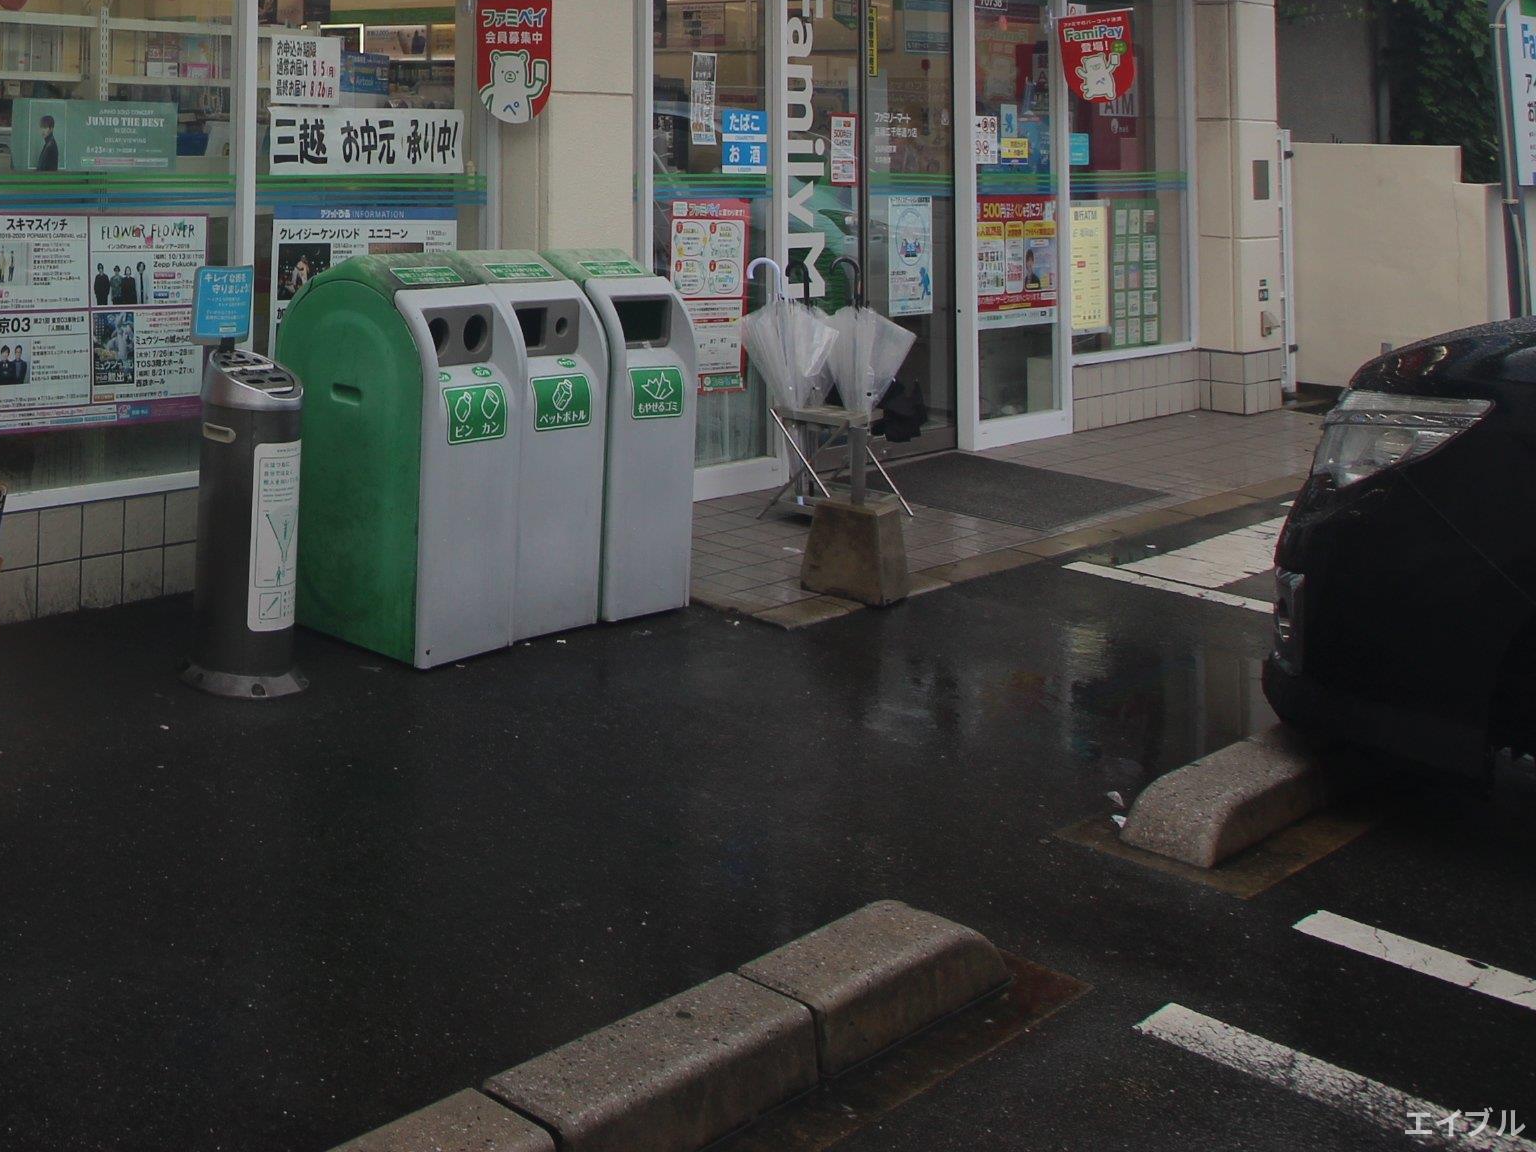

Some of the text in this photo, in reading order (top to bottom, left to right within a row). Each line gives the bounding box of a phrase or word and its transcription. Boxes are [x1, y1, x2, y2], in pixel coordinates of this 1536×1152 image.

[482, 8, 547, 27] ファミペイ
[486, 32, 542, 44] 会員募集中
[1063, 25, 1124, 42] FamiPay
[276, 59, 308, 76] 通常お届け
[503, 102, 520, 115] ペ
[86, 116, 165, 128] JUNHO THE BEST
[729, 113, 760, 132] たばこ
[874, 111, 912, 124] ファミリーマート
[273, 118, 459, 165] 三越 お中元 承り中!
[352, 209, 405, 219] INFORMATION
[6, 217, 68, 231] スキマスイッチ
[101, 223, 195, 240] FLOWER FLOWER
[279, 227, 409, 240] クレイジーケンバンド ユニコーン
[637, 402, 678, 413] もやせるゴミ
[539, 411, 587, 425] ペットボトル
[481, 422, 500, 434] カン
